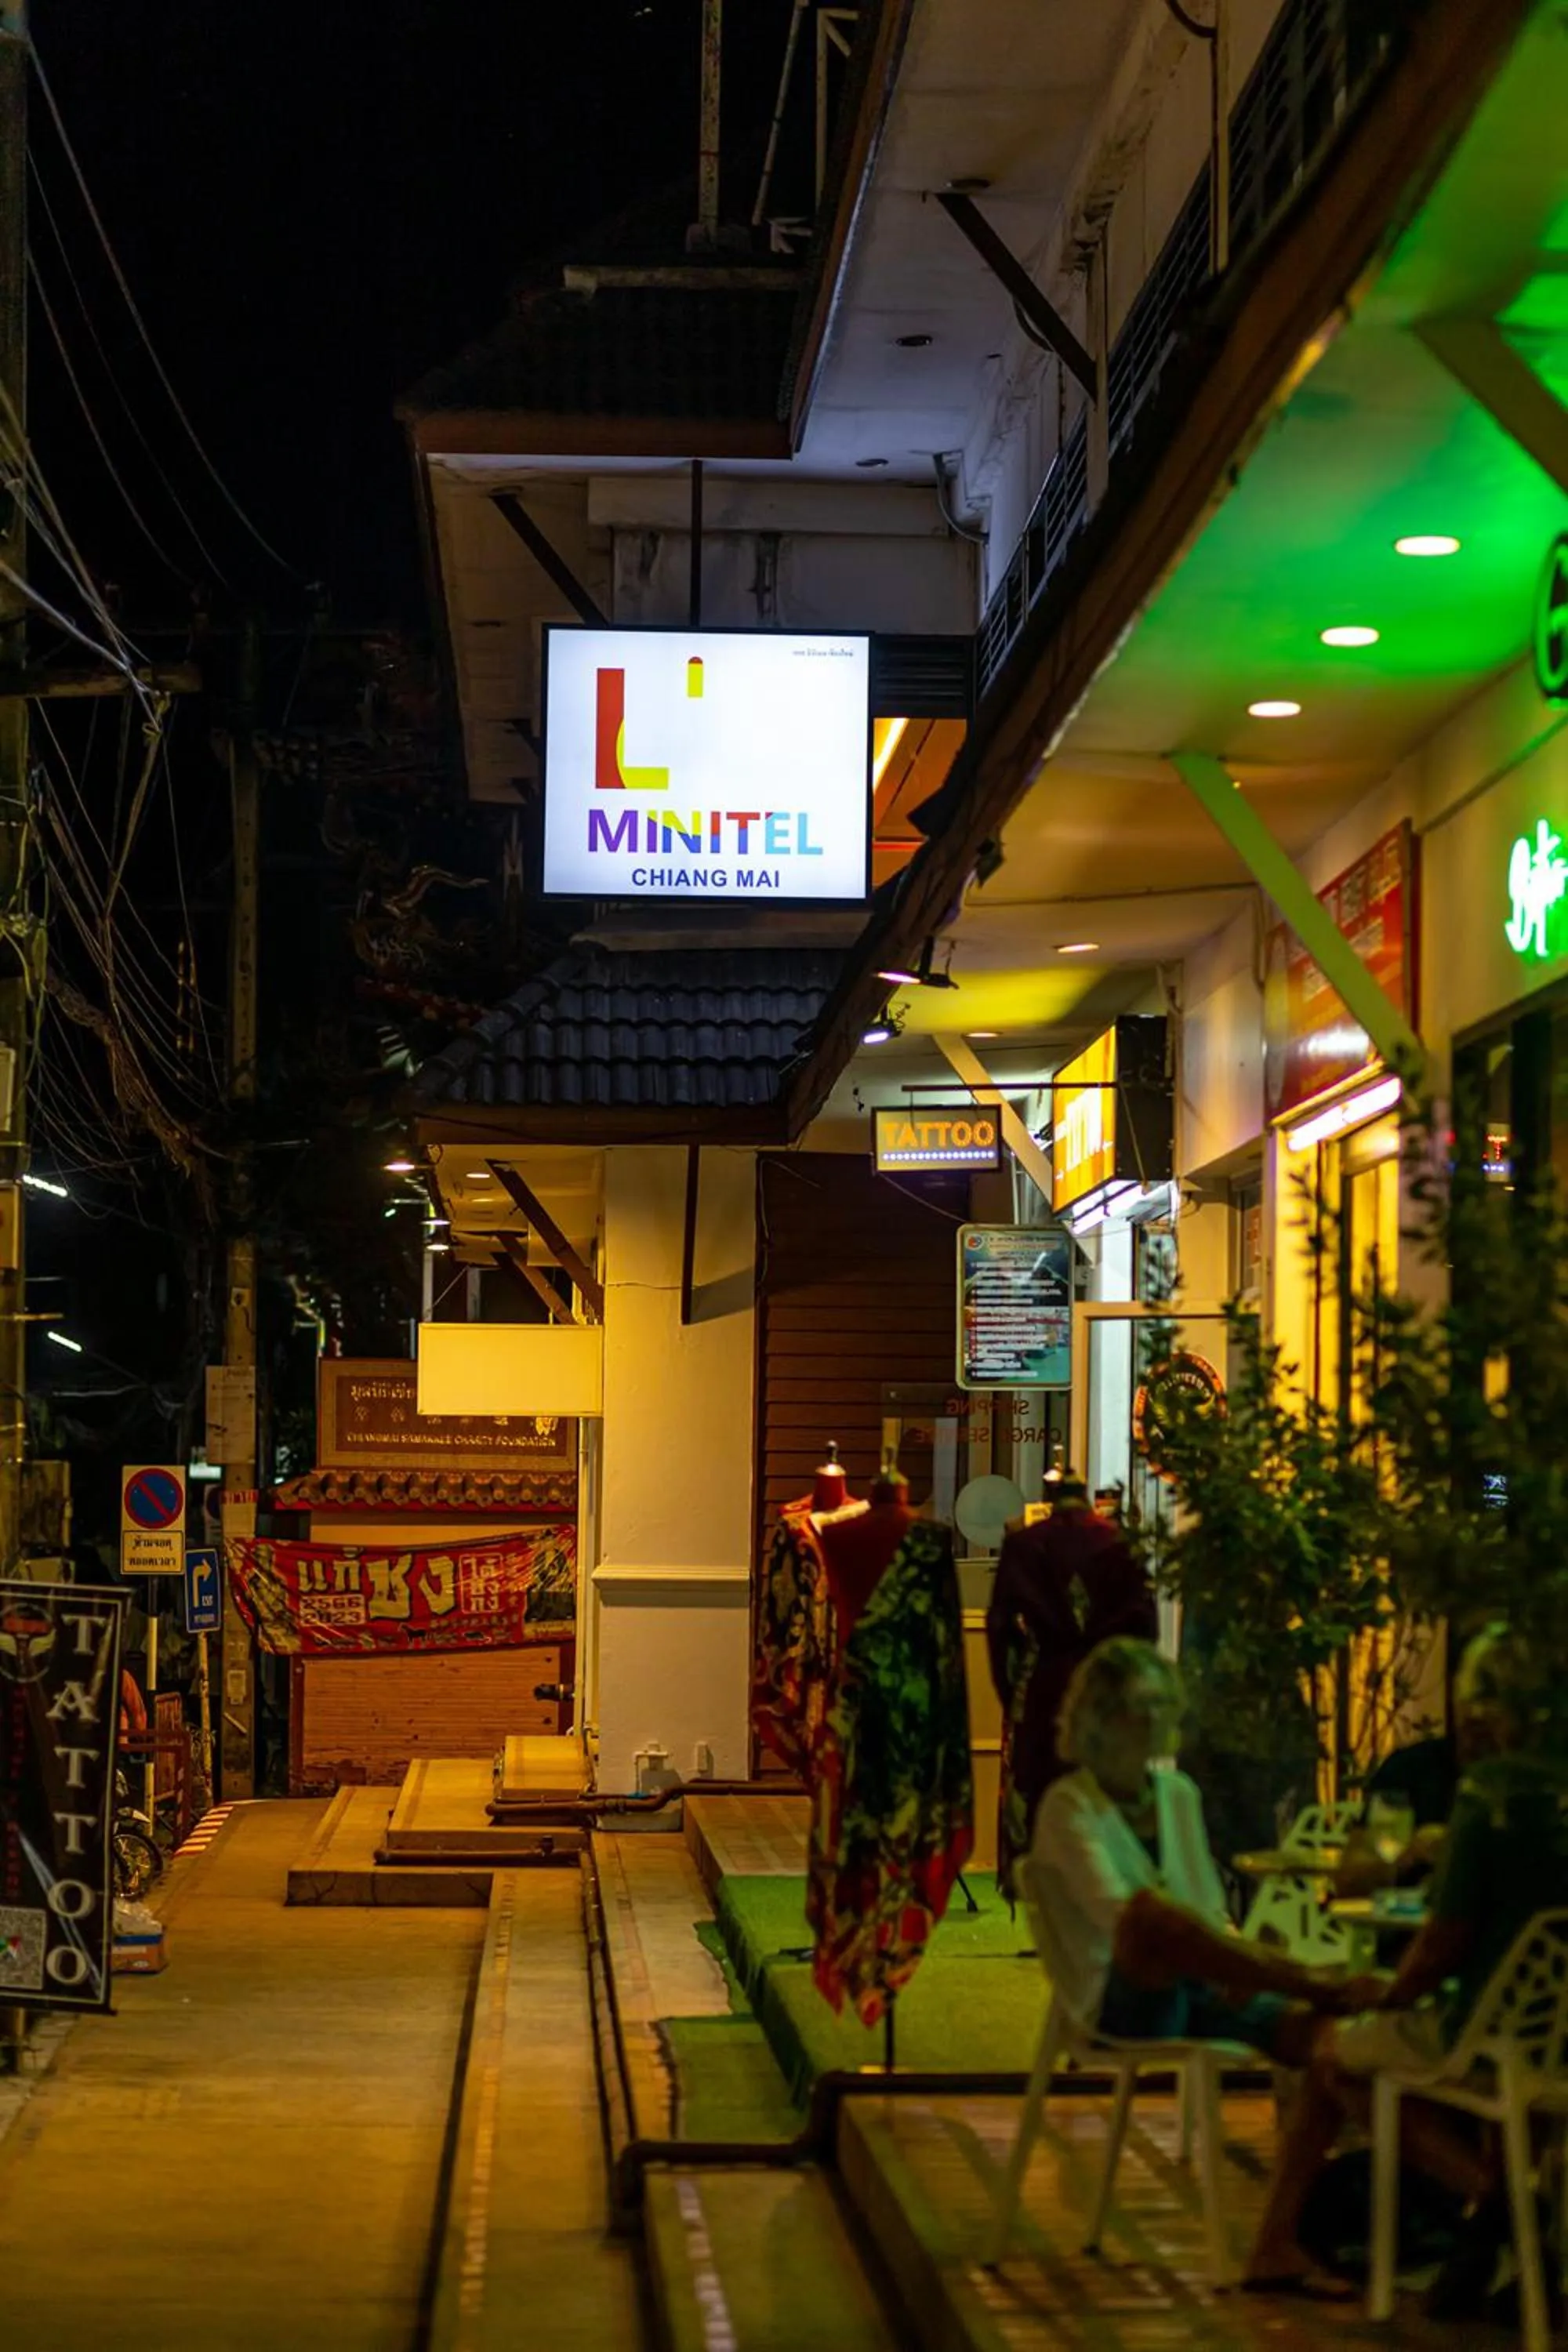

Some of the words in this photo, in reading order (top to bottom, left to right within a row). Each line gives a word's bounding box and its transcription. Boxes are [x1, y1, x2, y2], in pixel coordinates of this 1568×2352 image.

[587, 808, 824, 856] MINITEL
[631, 868, 728, 887] CHIANG
[735, 869, 780, 887] MAI
[882, 1120, 995, 1149] TATTOO
[302, 1596, 361, 1609] 2566
[45, 1613, 107, 1985] TATTOO
